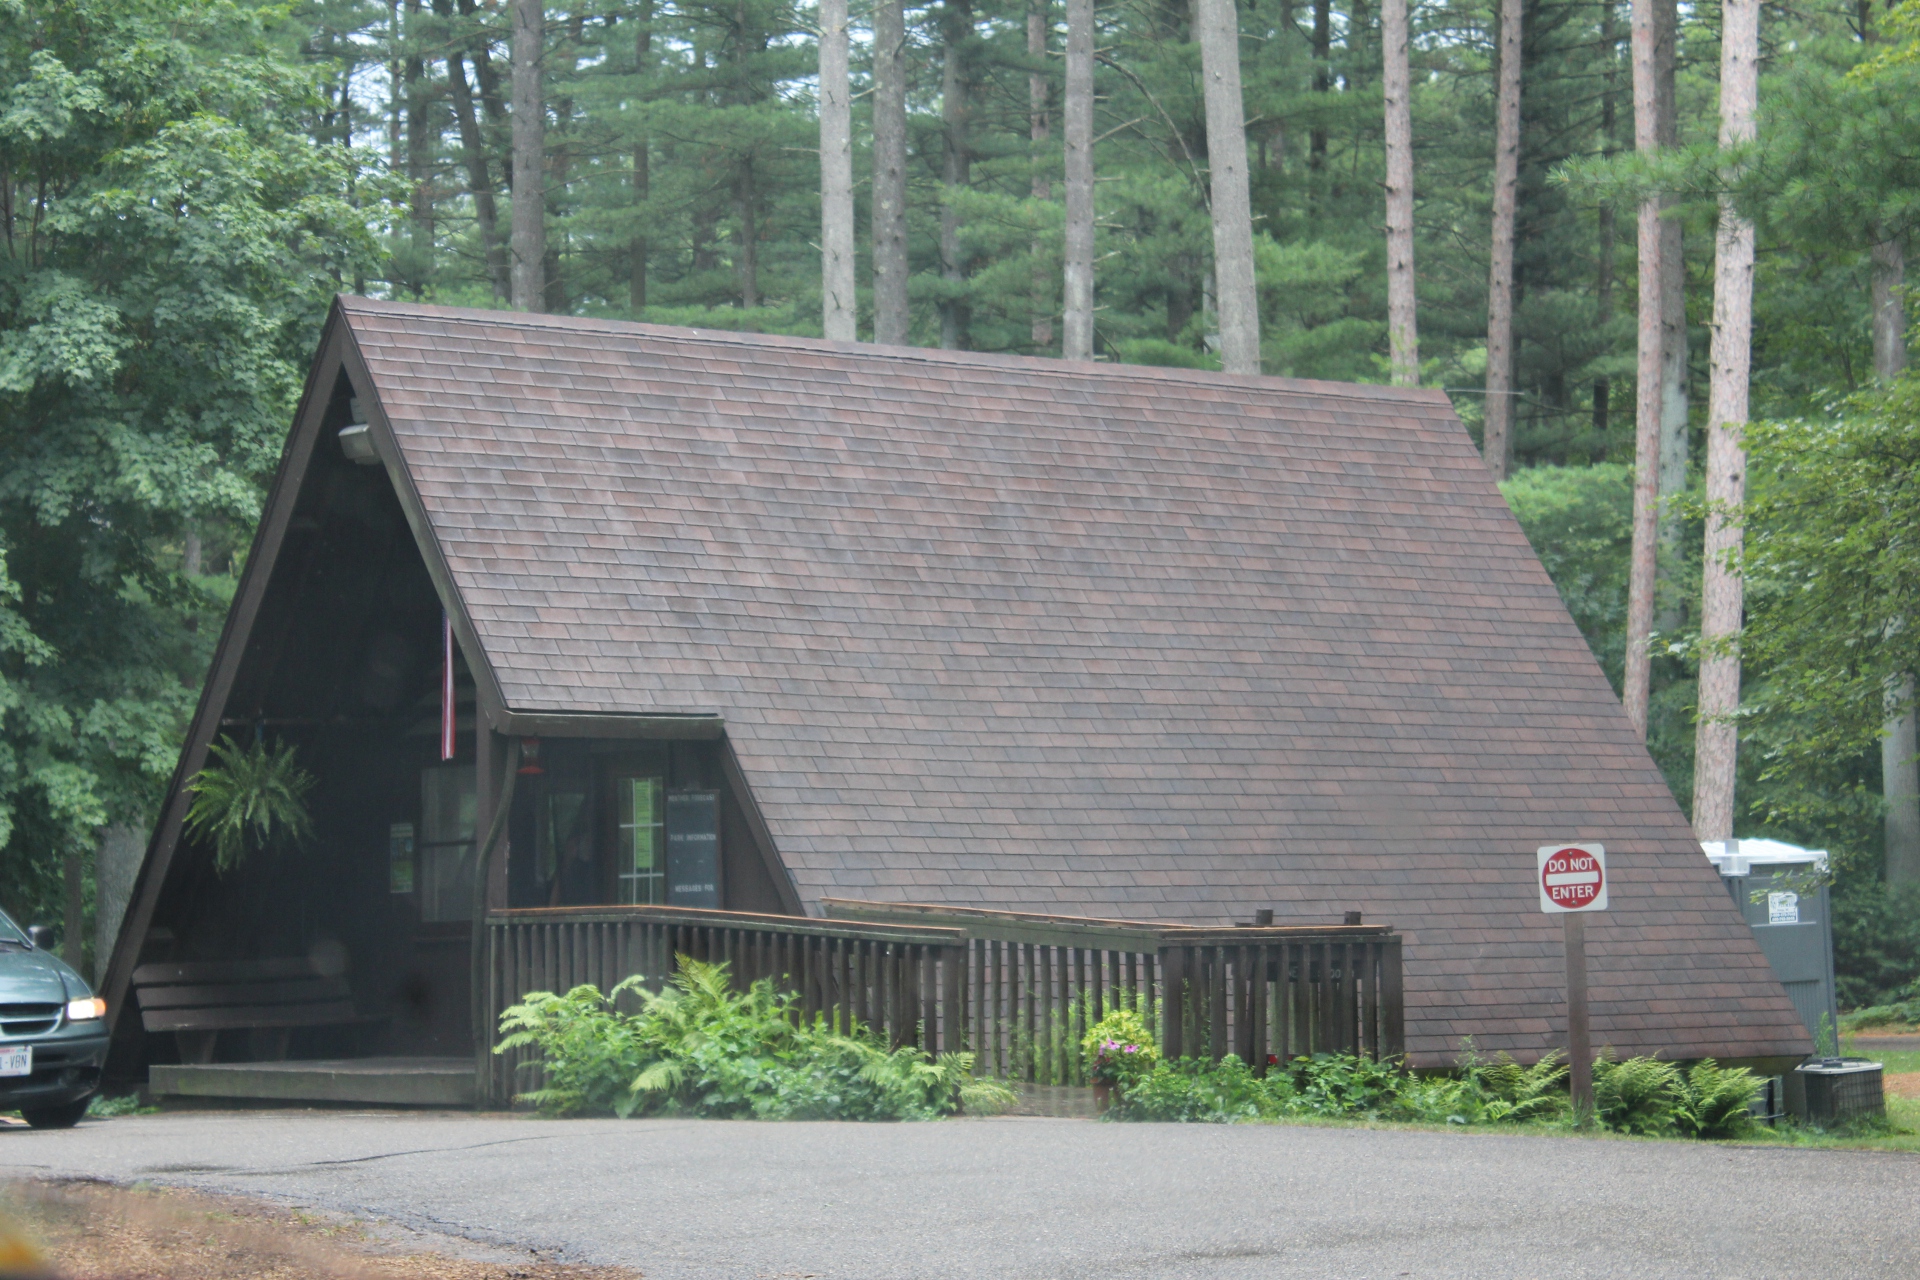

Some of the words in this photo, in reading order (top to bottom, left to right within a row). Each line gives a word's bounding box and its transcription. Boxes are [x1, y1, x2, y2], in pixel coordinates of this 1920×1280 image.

[686, 833, 716, 841] INFORMATION
[1548, 860, 1567, 872] DO
[1570, 857, 1594, 871] NOT
[675, 884, 702, 892] MESSAGES
[704, 884, 714, 892] FOR
[1552, 885, 1594, 900] ENTER
